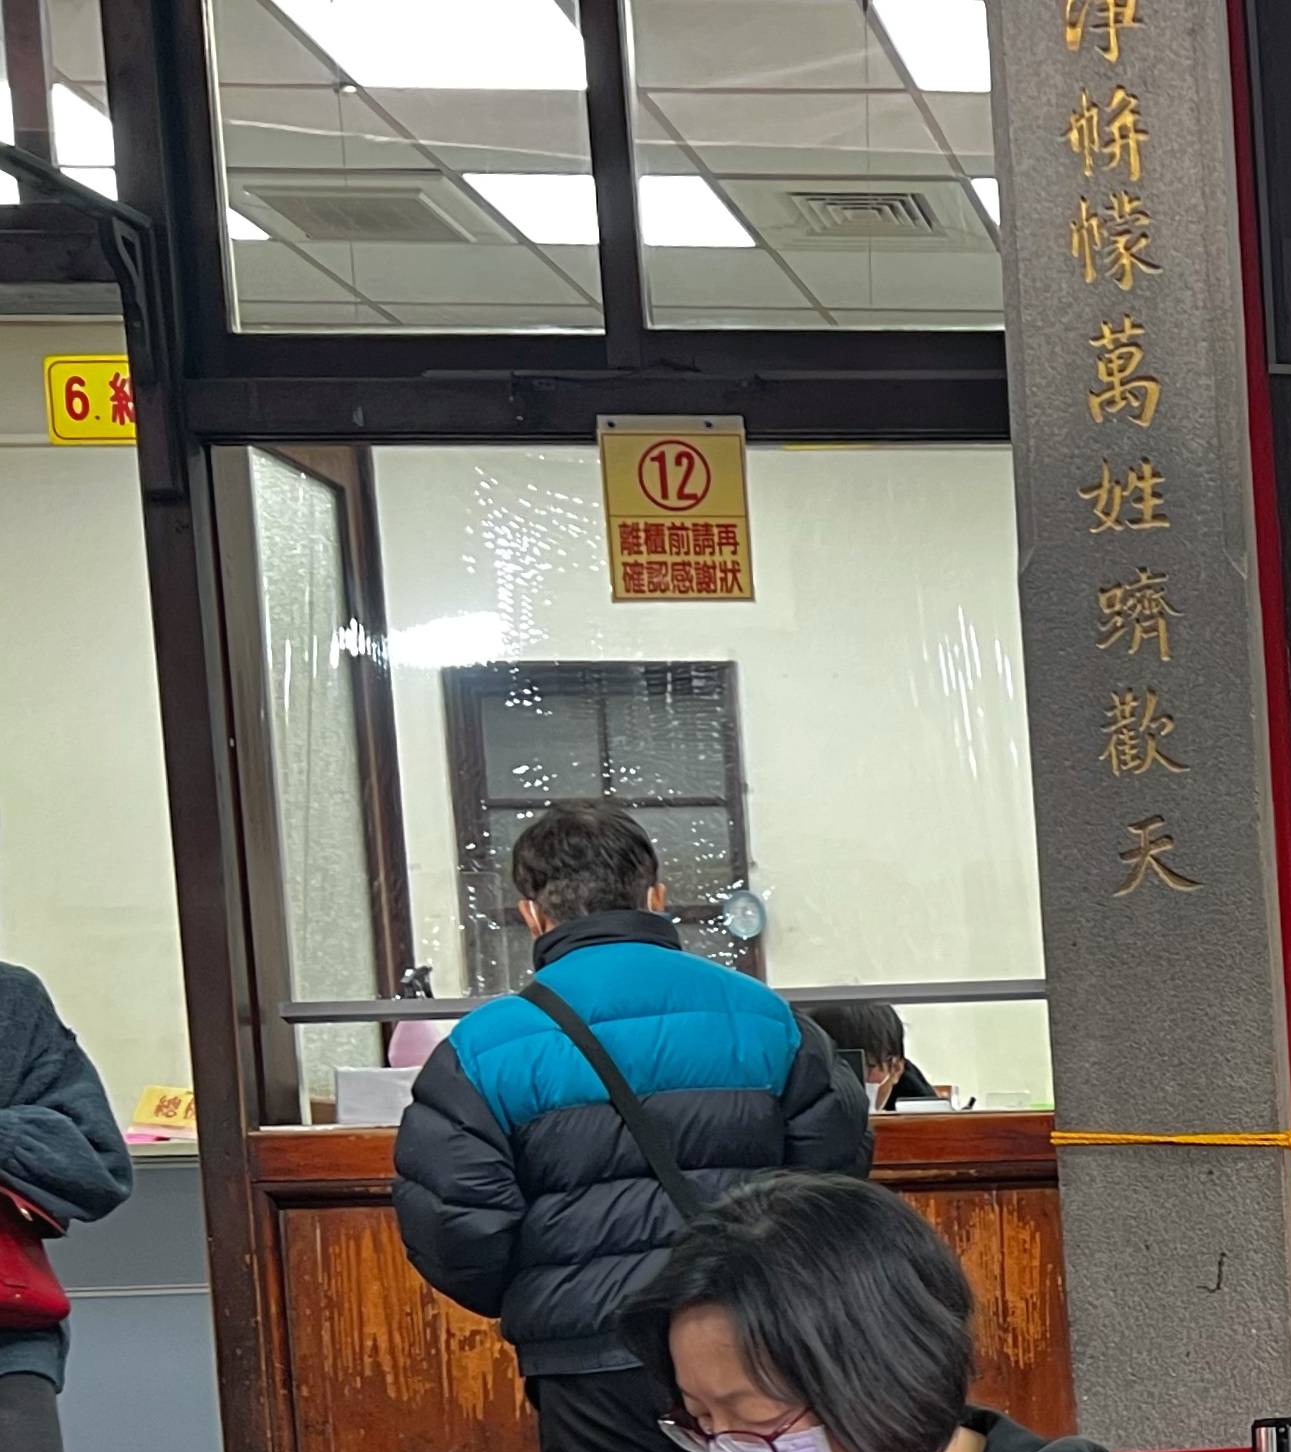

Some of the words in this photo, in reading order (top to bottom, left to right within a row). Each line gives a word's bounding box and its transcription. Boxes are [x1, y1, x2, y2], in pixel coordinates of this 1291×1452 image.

[618, 520, 740, 557] 離櫃前請再
[620, 558, 744, 596] 確認感謝狀
